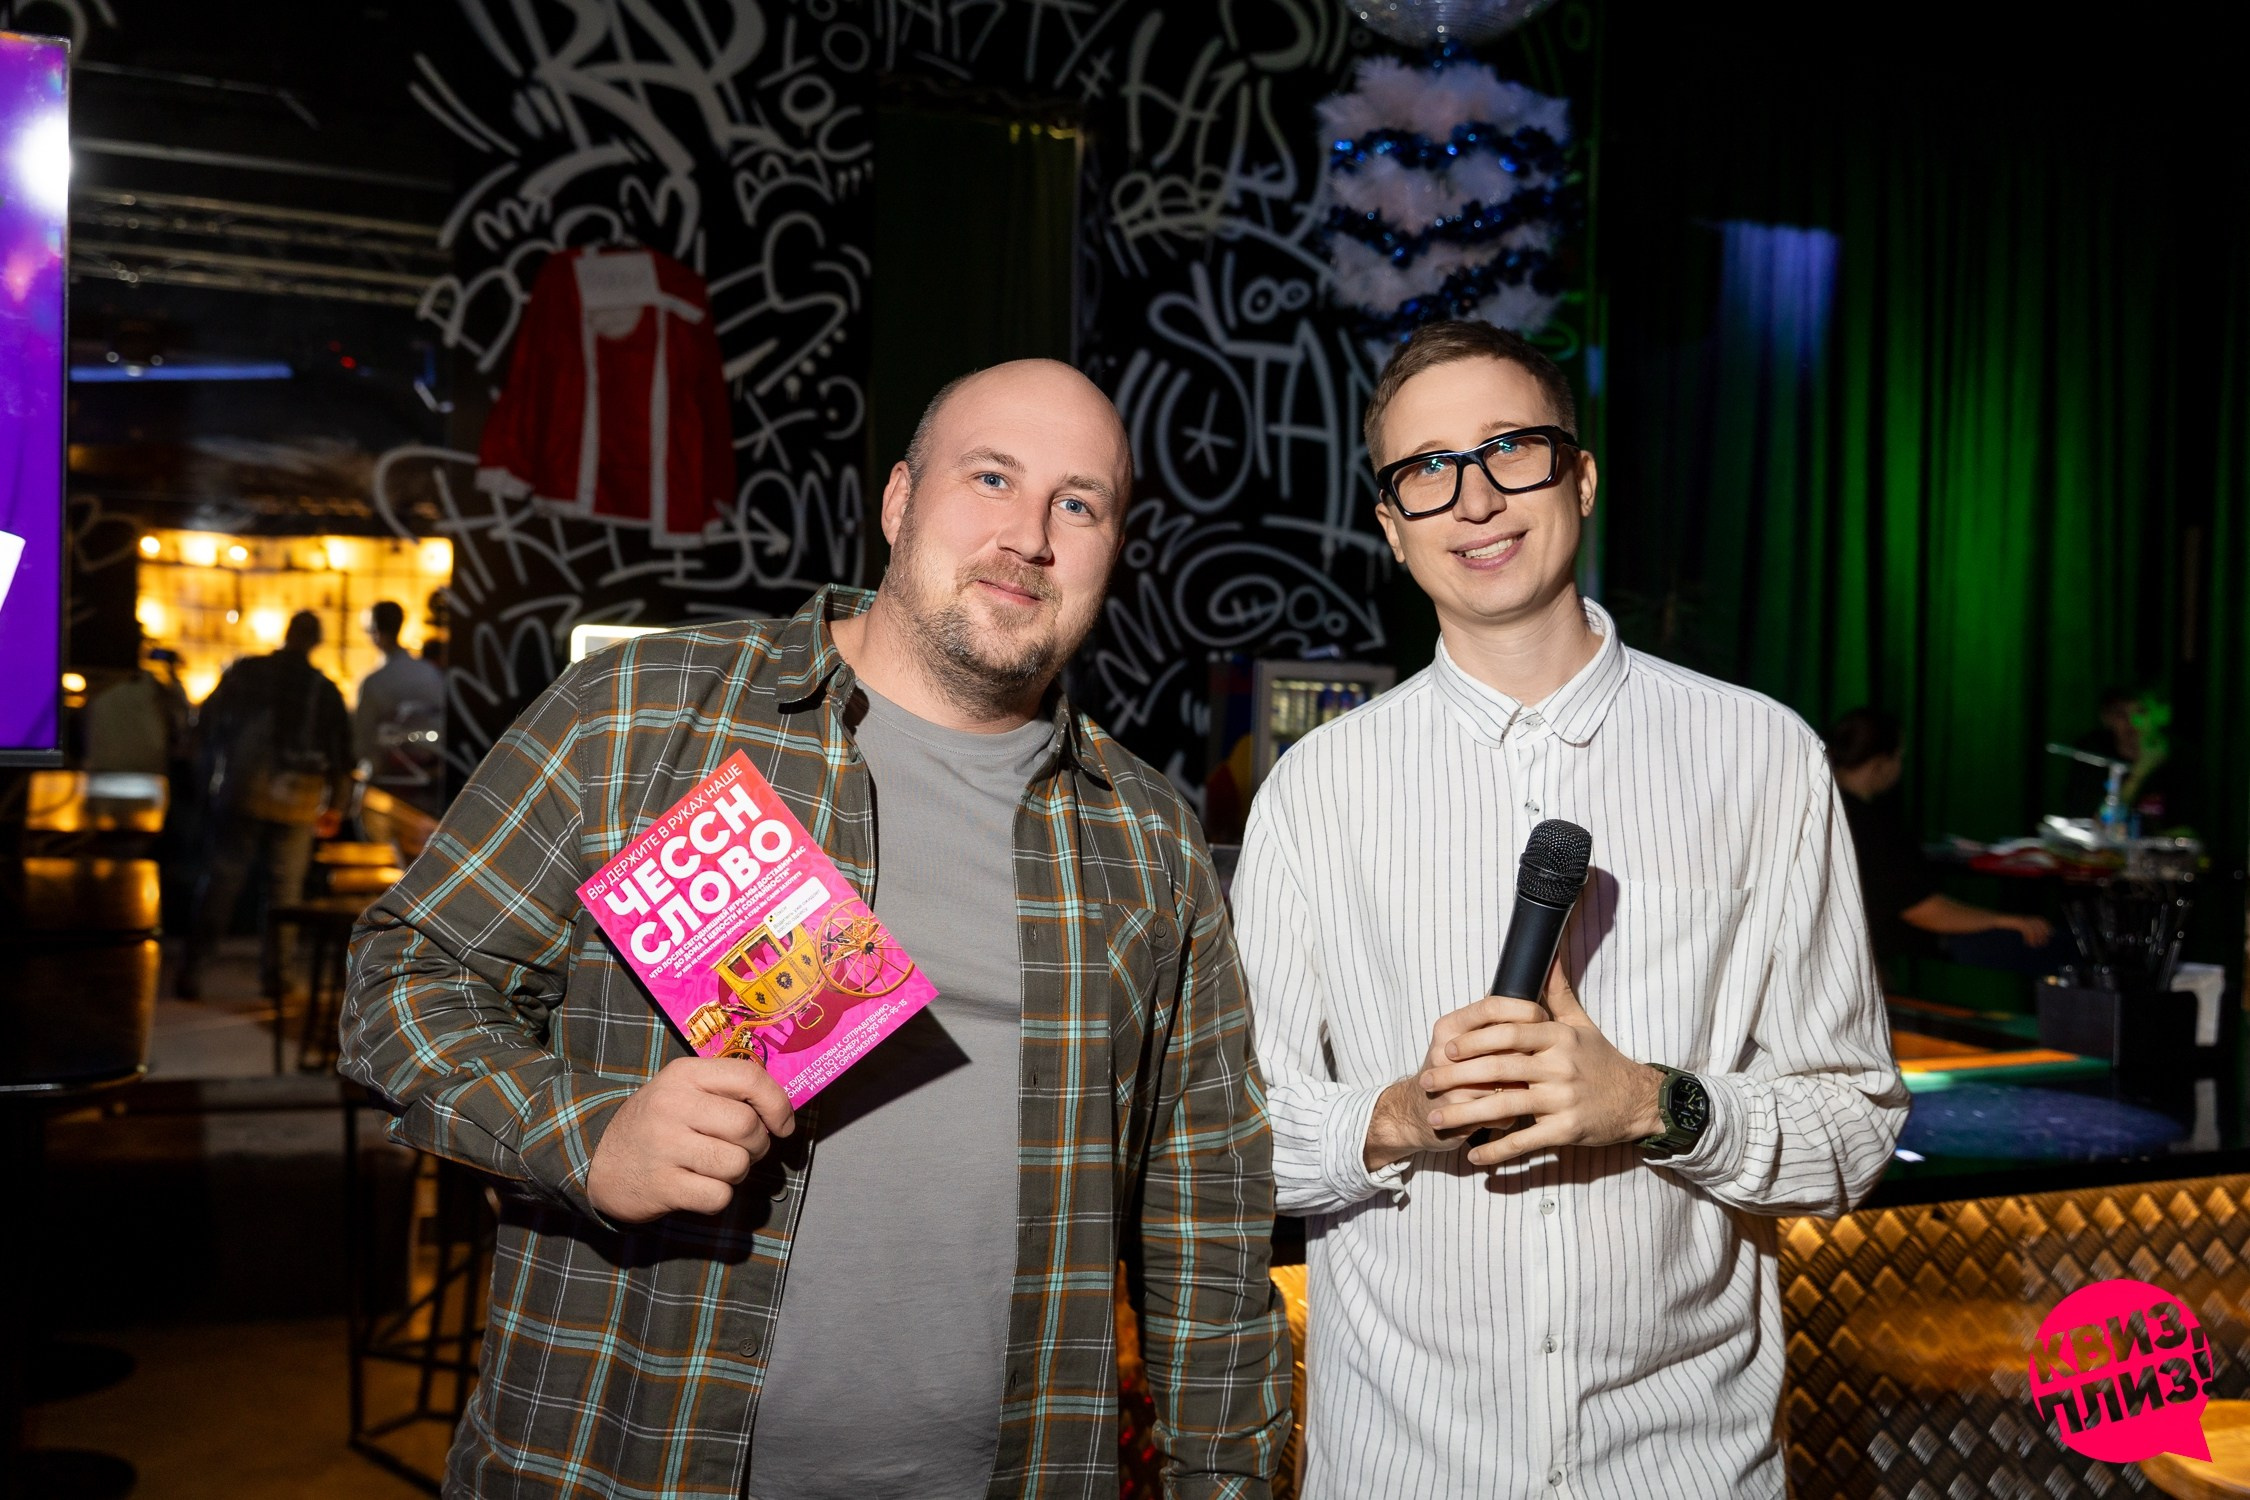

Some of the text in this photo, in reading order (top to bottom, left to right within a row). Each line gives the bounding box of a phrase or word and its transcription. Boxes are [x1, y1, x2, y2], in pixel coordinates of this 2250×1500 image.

[586, 762, 742, 900] ВЫ ДЕРЖИТЕ В РУКАХ НАШЕ
[603, 782, 763, 919] ЧЕССН
[630, 819, 793, 965] СЛОВО
[648, 844, 807, 980] ЧТО ПОСЛЕ СЕГОДНЯШНЕЙ ИГРЫ МЫ ДОСТАВИМ ВАС
[672, 956, 685, 969] ДО
[682, 940, 704, 961] ДОМА
[706, 912, 738, 941] ЦЕЛОСТИ
[786, 1077, 810, 1099] ОНИТЕ
[807, 1065, 825, 1081] НАМ
[822, 1057, 835, 1069] ПО
[832, 1036, 861, 1061] НОМЕРУ
[858, 1030, 868, 1039] +7
[865, 1021, 879, 1034] 993
[788, 1065, 814, 1088] БУДЕТЕ
[810, 1044, 838, 1069] ГОТОВЫ
[840, 1001, 892, 1044] ОТПРАВЛЕНИЮ,
[807, 1030, 880, 1091] И МЫ ВСЁ ОРГАНИЗУЕМ
